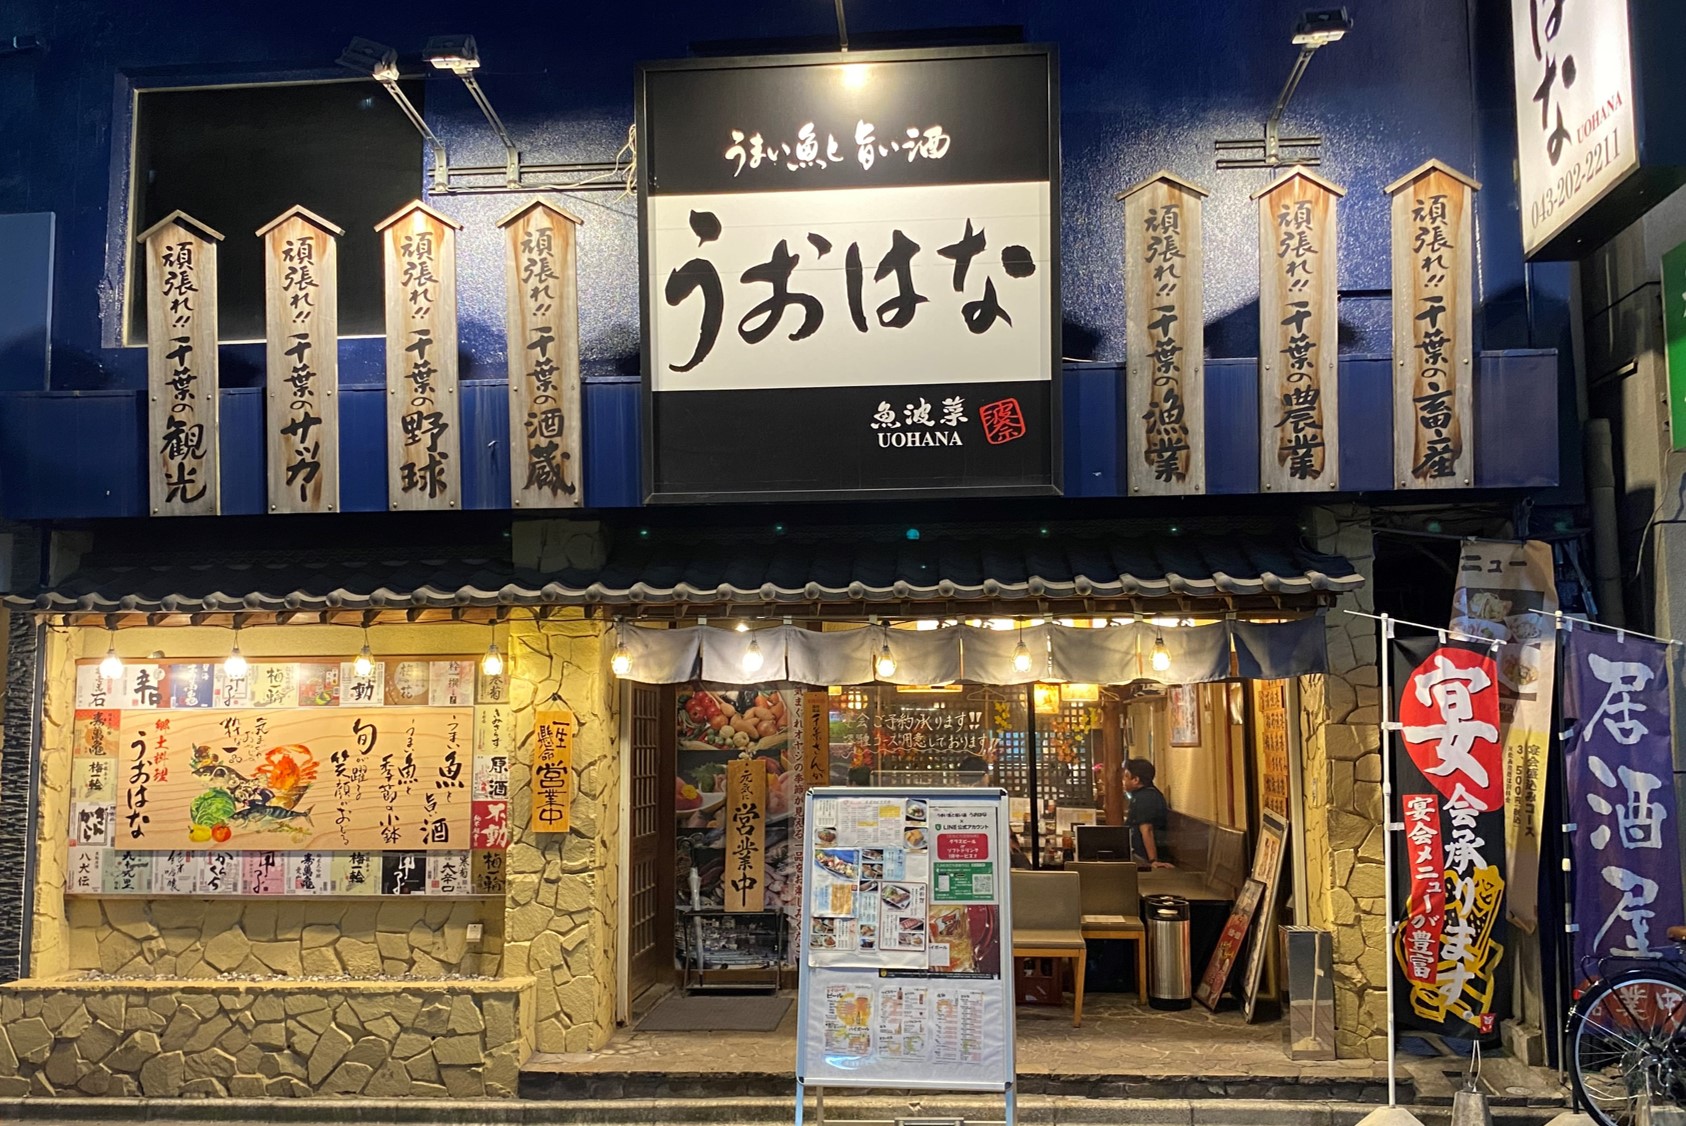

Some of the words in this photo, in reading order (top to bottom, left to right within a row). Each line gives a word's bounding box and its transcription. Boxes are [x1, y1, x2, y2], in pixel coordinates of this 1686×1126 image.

[1577, 90, 1623, 144] UOHANA
[1531, 127, 1621, 229] 043-202-2211
[665, 209, 1036, 373] うおはな
[870, 396, 969, 430] 魚波菜
[877, 432, 964, 448] UOHANA
[153, 718, 171, 783] 郷土料理
[488, 755, 509, 797] 原酒
[125, 730, 152, 839] うおはな
[534, 760, 568, 826] 営業中
[1582, 652, 1668, 959] 居酒屋
[480, 802, 509, 849] 不動
[1401, 654, 1500, 1007] 宴会承ります
[348, 851, 366, 884] 梅一輪
[440, 862, 458, 893] 大辛口
[1404, 796, 1443, 980] 宴会メニューが豊富
